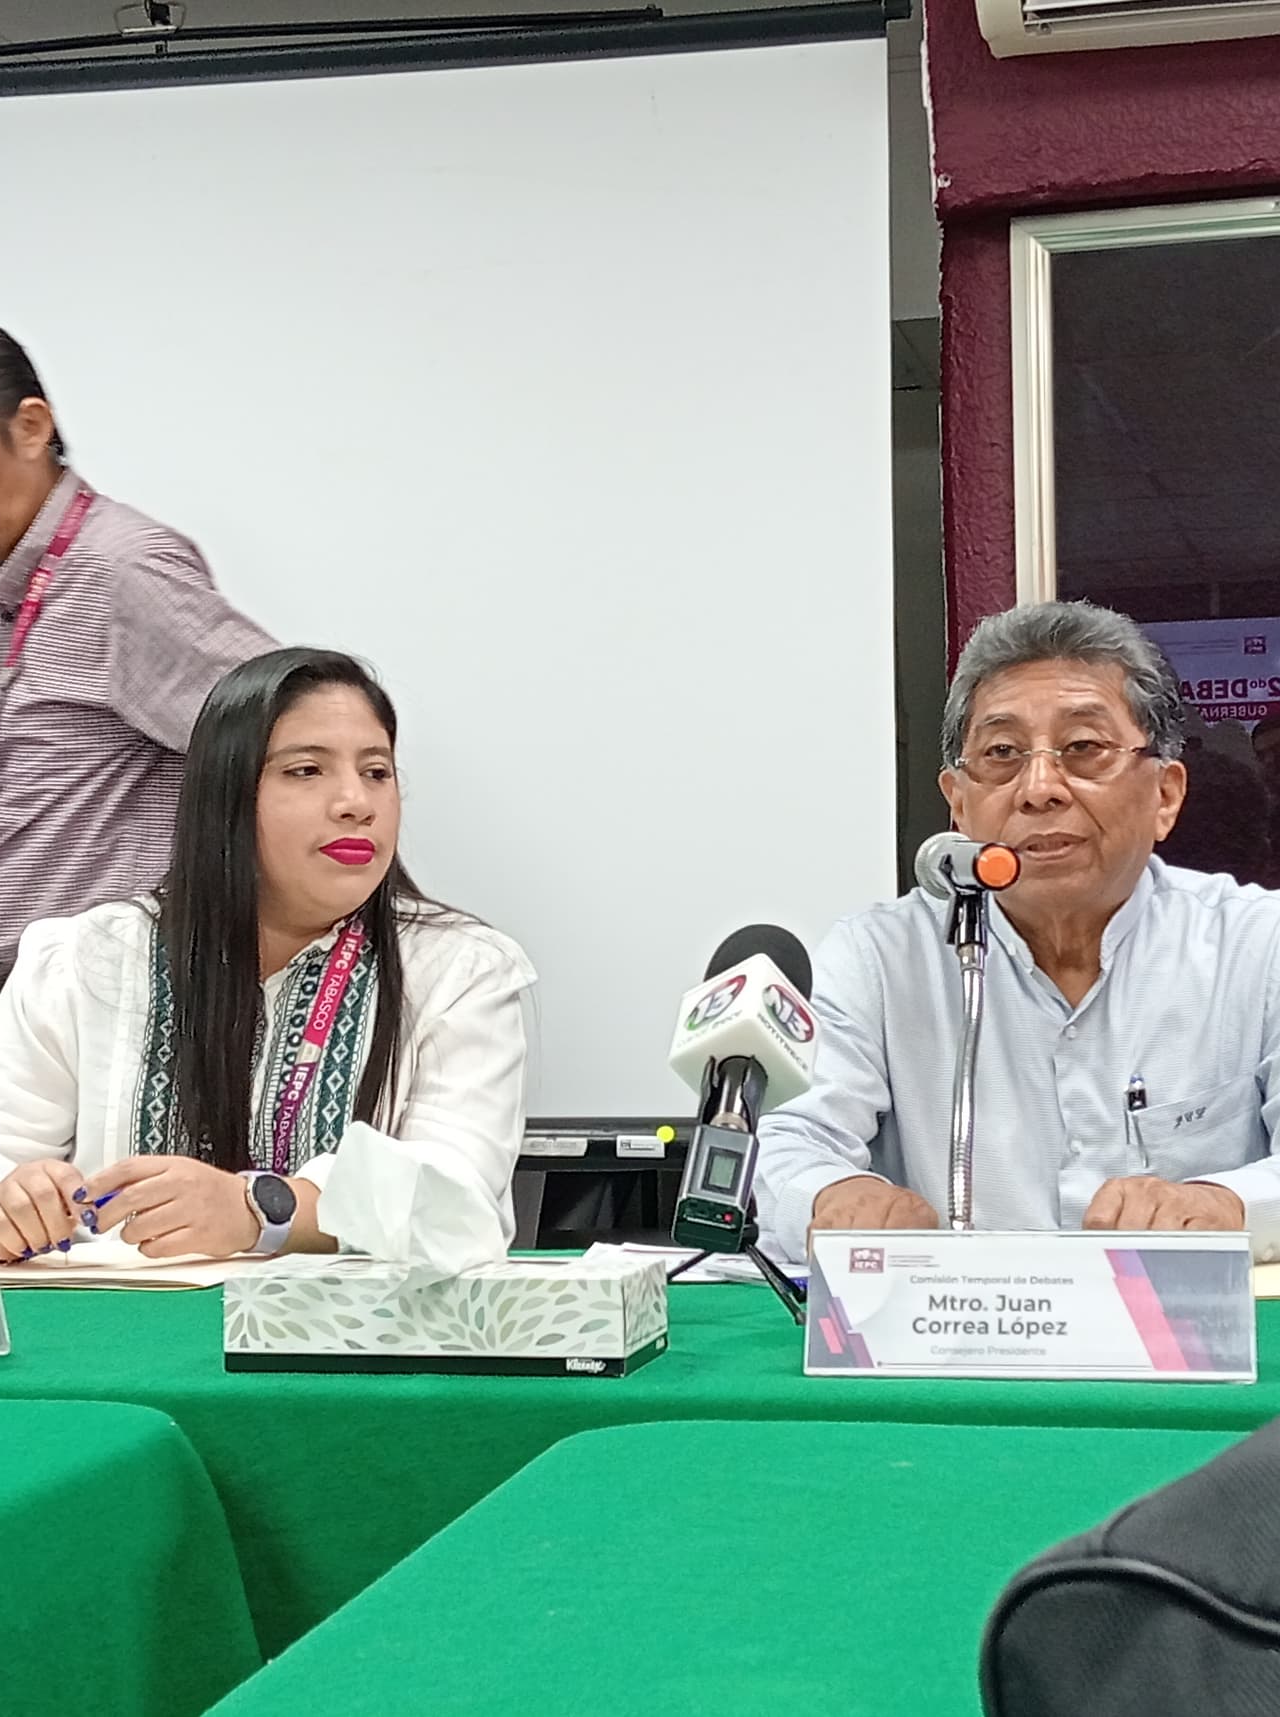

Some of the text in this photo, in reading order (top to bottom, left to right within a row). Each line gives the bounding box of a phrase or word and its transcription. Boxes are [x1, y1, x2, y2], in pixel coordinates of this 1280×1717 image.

[313, 937, 357, 1031] IEPC TABASCO
[274, 1066, 310, 1169] IEPC TABASCO
[1029, 1275, 1074, 1285] Debates
[928, 1294, 1052, 1312] Mtro. Juan
[912, 1315, 1068, 1339] Correa López
